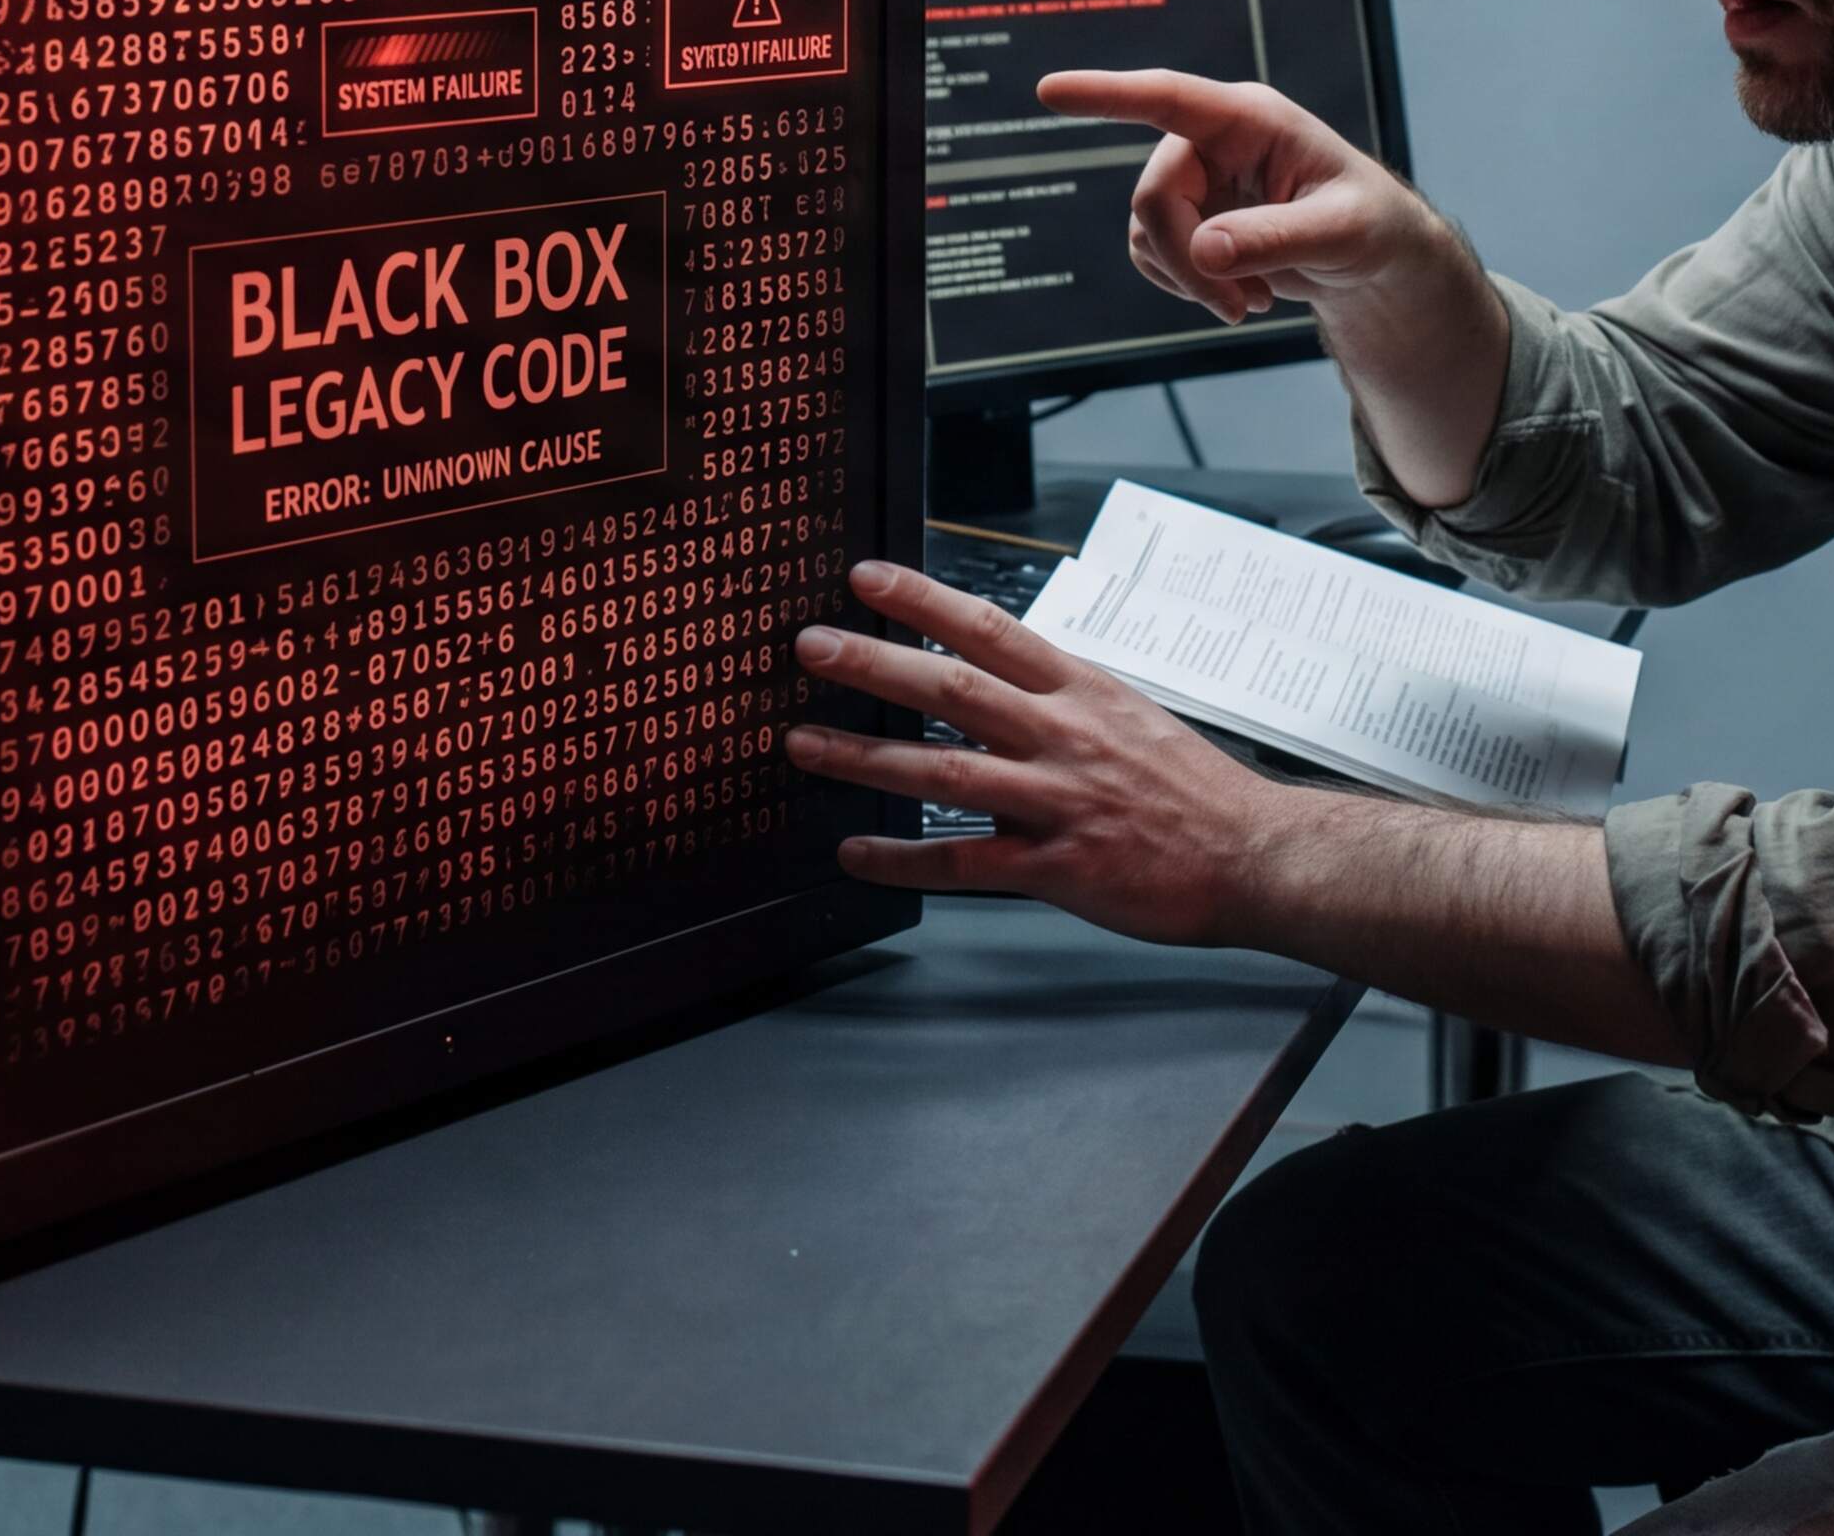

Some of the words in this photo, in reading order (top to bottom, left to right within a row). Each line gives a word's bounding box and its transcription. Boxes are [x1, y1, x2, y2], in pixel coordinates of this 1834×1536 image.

[338, 78, 425, 111] SYSTEM
[433, 68, 523, 102] FAILURE
[231, 243, 469, 359] BLACK
[494, 223, 628, 320] BOX
[231, 351, 465, 455] LEGACY
[482, 325, 628, 411] CODE
[265, 474, 371, 524] ERROR:
[520, 428, 603, 474] CAUSE
